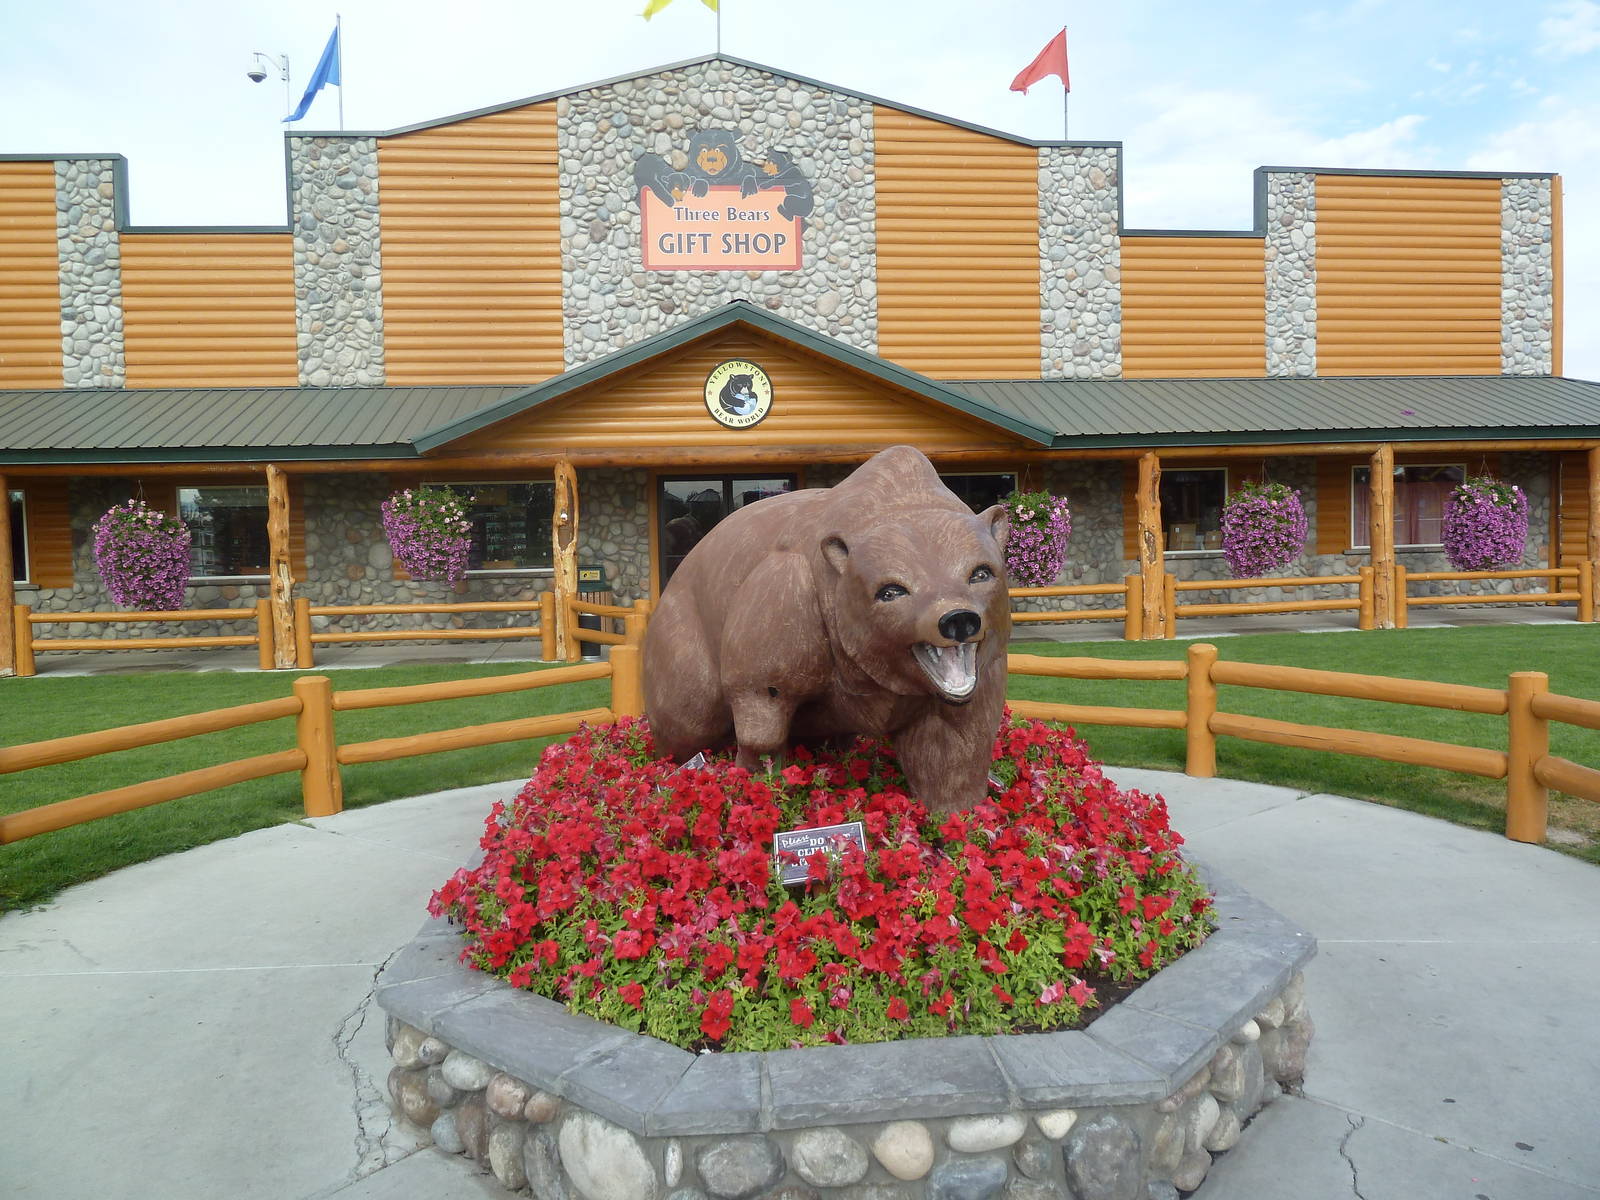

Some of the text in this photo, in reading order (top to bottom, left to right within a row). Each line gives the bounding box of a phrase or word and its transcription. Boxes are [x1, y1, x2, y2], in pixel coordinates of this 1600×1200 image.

[673, 206, 770, 221] Three Bears
[658, 232, 787, 255] GIFT SHOP
[709, 362, 768, 386] YELLOWSTONE
[714, 407, 764, 424] BEAR WORLD
[810, 837, 824, 846] DO
